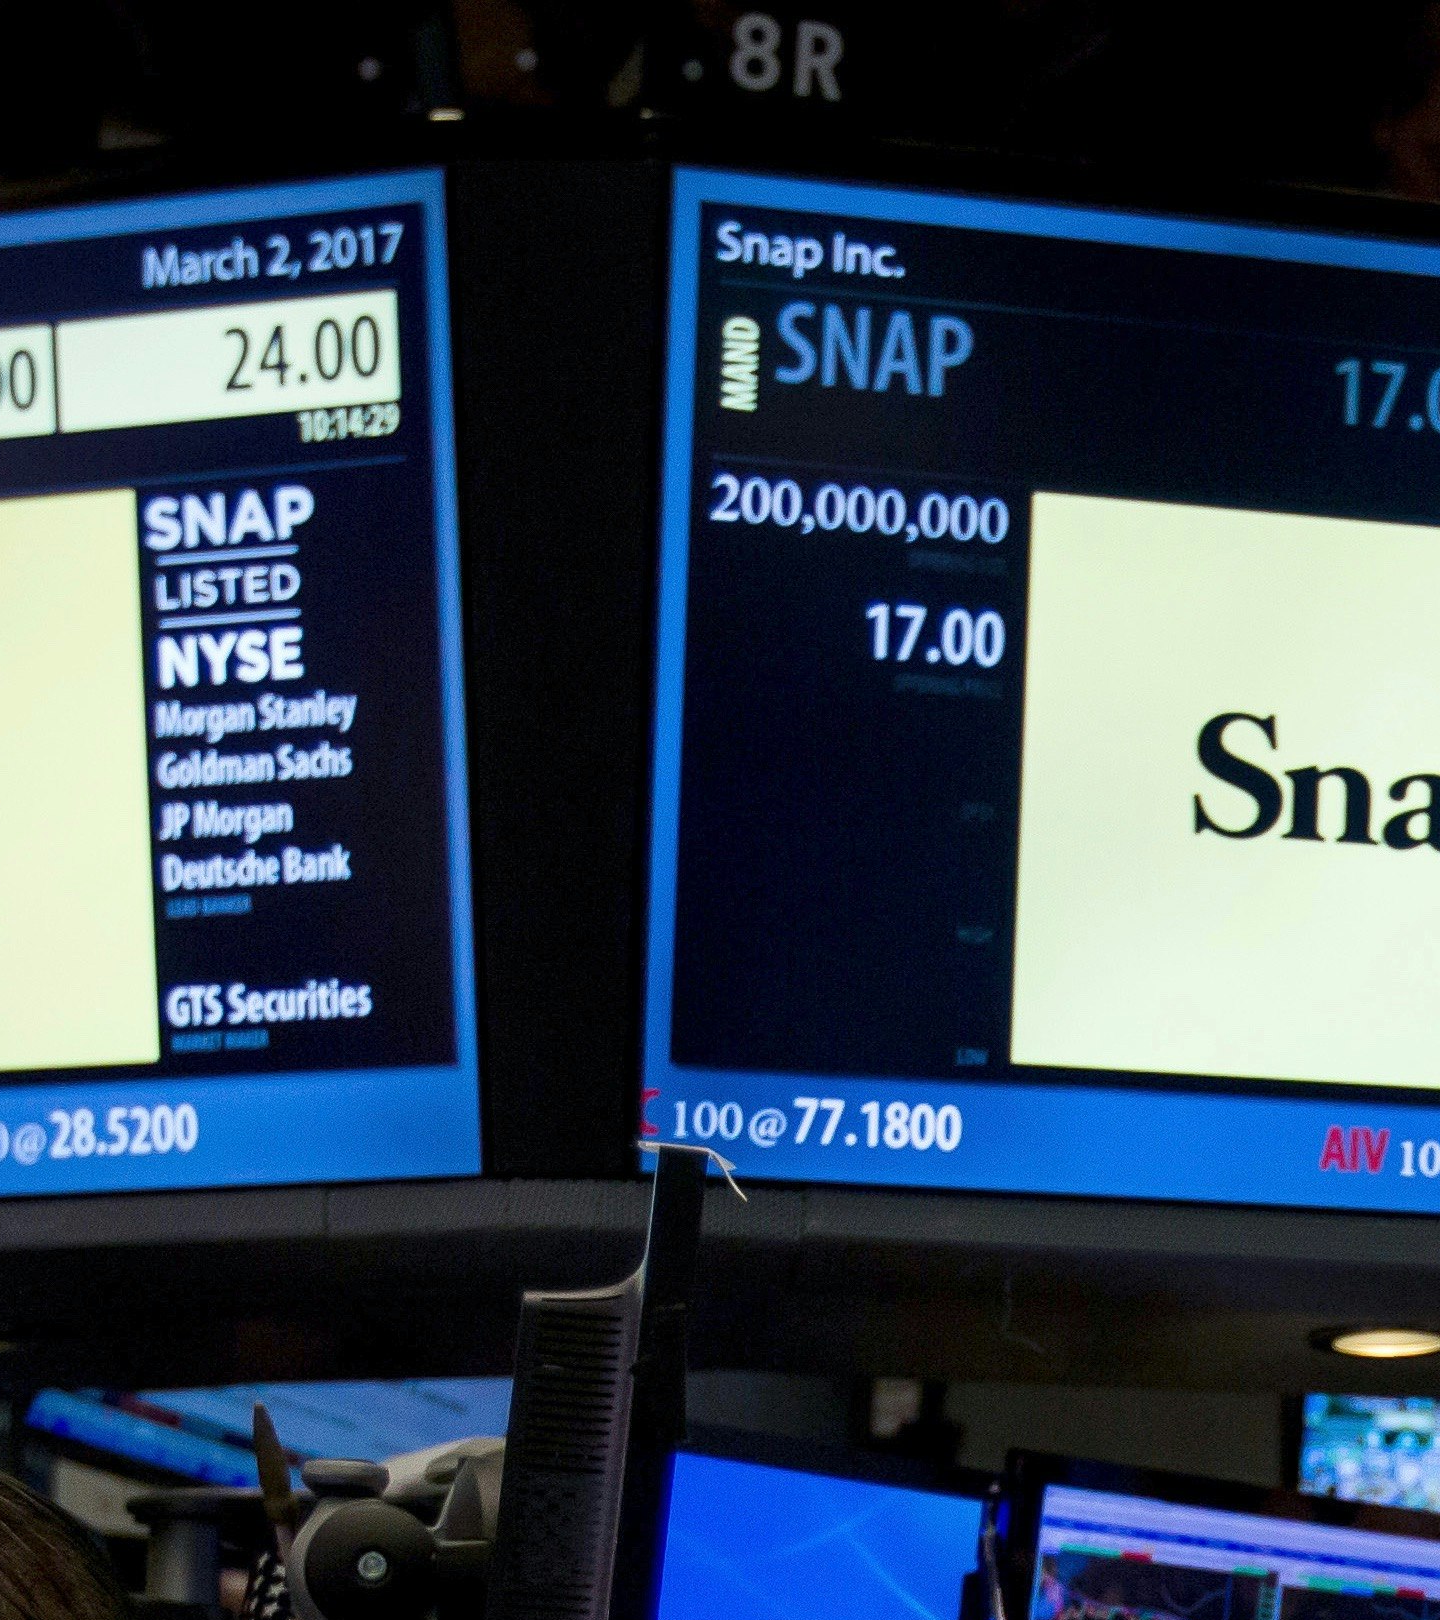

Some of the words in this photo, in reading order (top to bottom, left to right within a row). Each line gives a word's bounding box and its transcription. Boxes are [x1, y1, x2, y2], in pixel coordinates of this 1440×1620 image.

[730, 12, 843, 101] 8R
[142, 238, 259, 290] March
[266, 233, 301, 279] 2,
[308, 222, 403, 274] 2017
[716, 220, 823, 279] Snap
[832, 230, 906, 279] Inc.
[224, 315, 381, 393] 24.00
[720, 314, 761, 412] MAND
[774, 300, 974, 398] SNAP
[144, 485, 315, 551] SNAP
[709, 474, 1010, 544] 200,000,000
[155, 564, 302, 612] LISTED
[156, 626, 305, 690] NYSE
[865, 602, 1006, 668] 17.00
[155, 701, 256, 744] Morgan
[259, 690, 357, 733] Stanley
[158, 749, 275, 790] Goldman
[277, 741, 353, 781] Sachs
[160, 801, 190, 842] JP
[192, 801, 294, 844] Morgan
[161, 850, 280, 892] Deutsche
[282, 844, 352, 884] Bank
[166, 984, 224, 1027] GTS
[226, 978, 373, 1025] Securities
[1320, 1125, 1391, 1174] AIV
